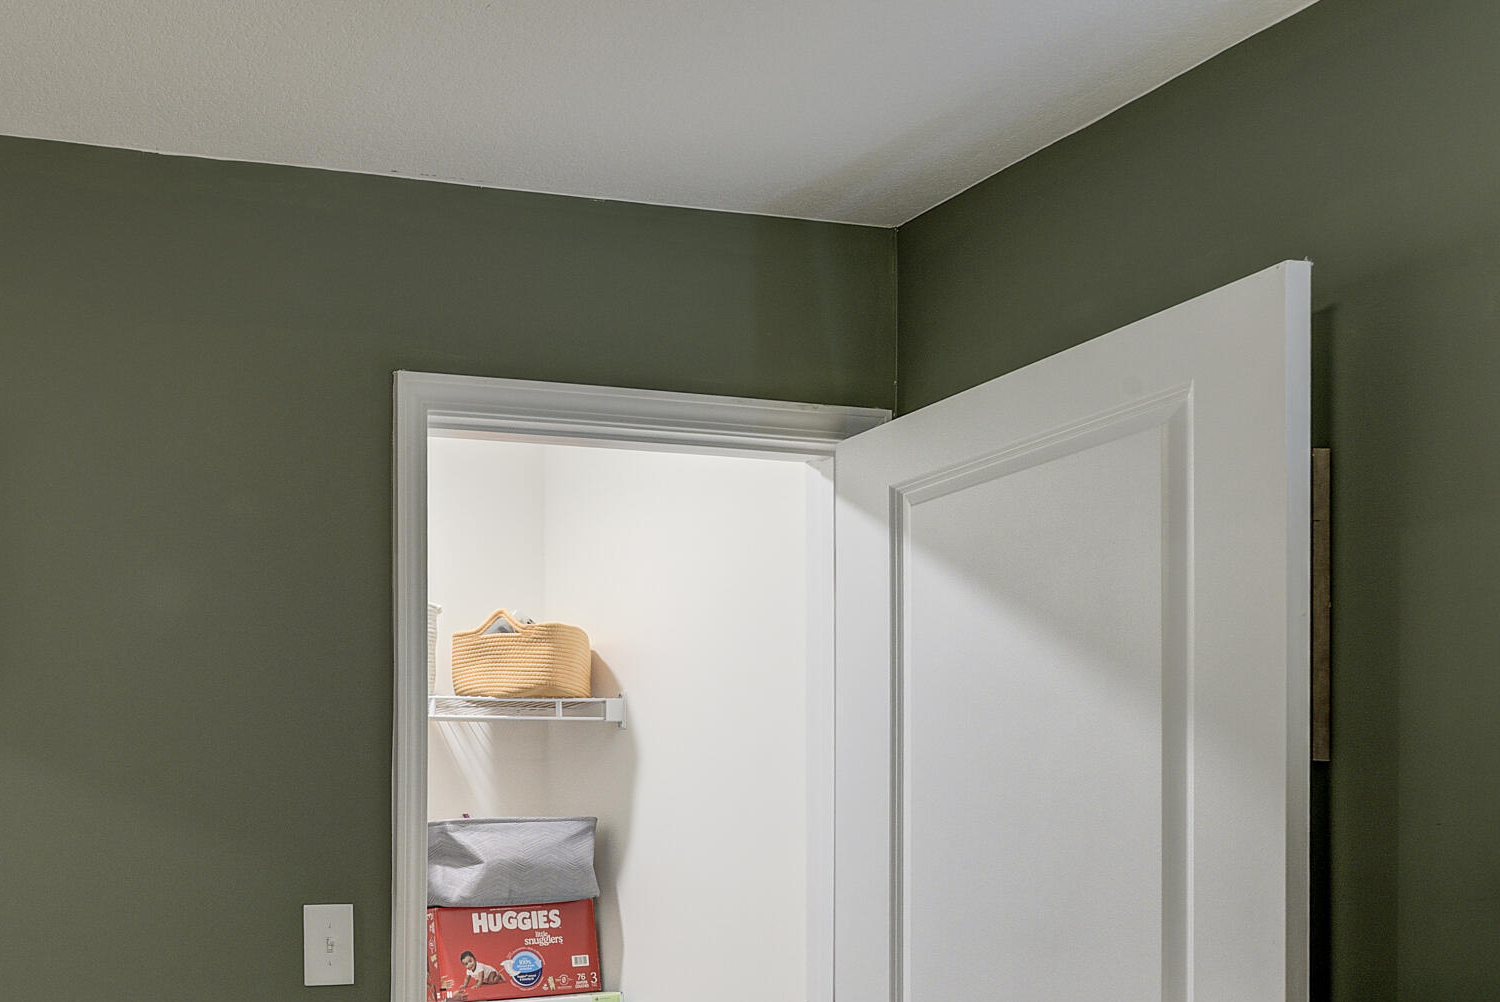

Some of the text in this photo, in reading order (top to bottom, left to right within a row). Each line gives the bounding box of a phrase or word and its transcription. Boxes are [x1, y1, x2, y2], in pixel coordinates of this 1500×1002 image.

[472, 909, 561, 933] HUGGIES
[524, 935, 563, 946] snugglers
[577, 972, 586, 981] 76
[590, 972, 598, 984] 3
